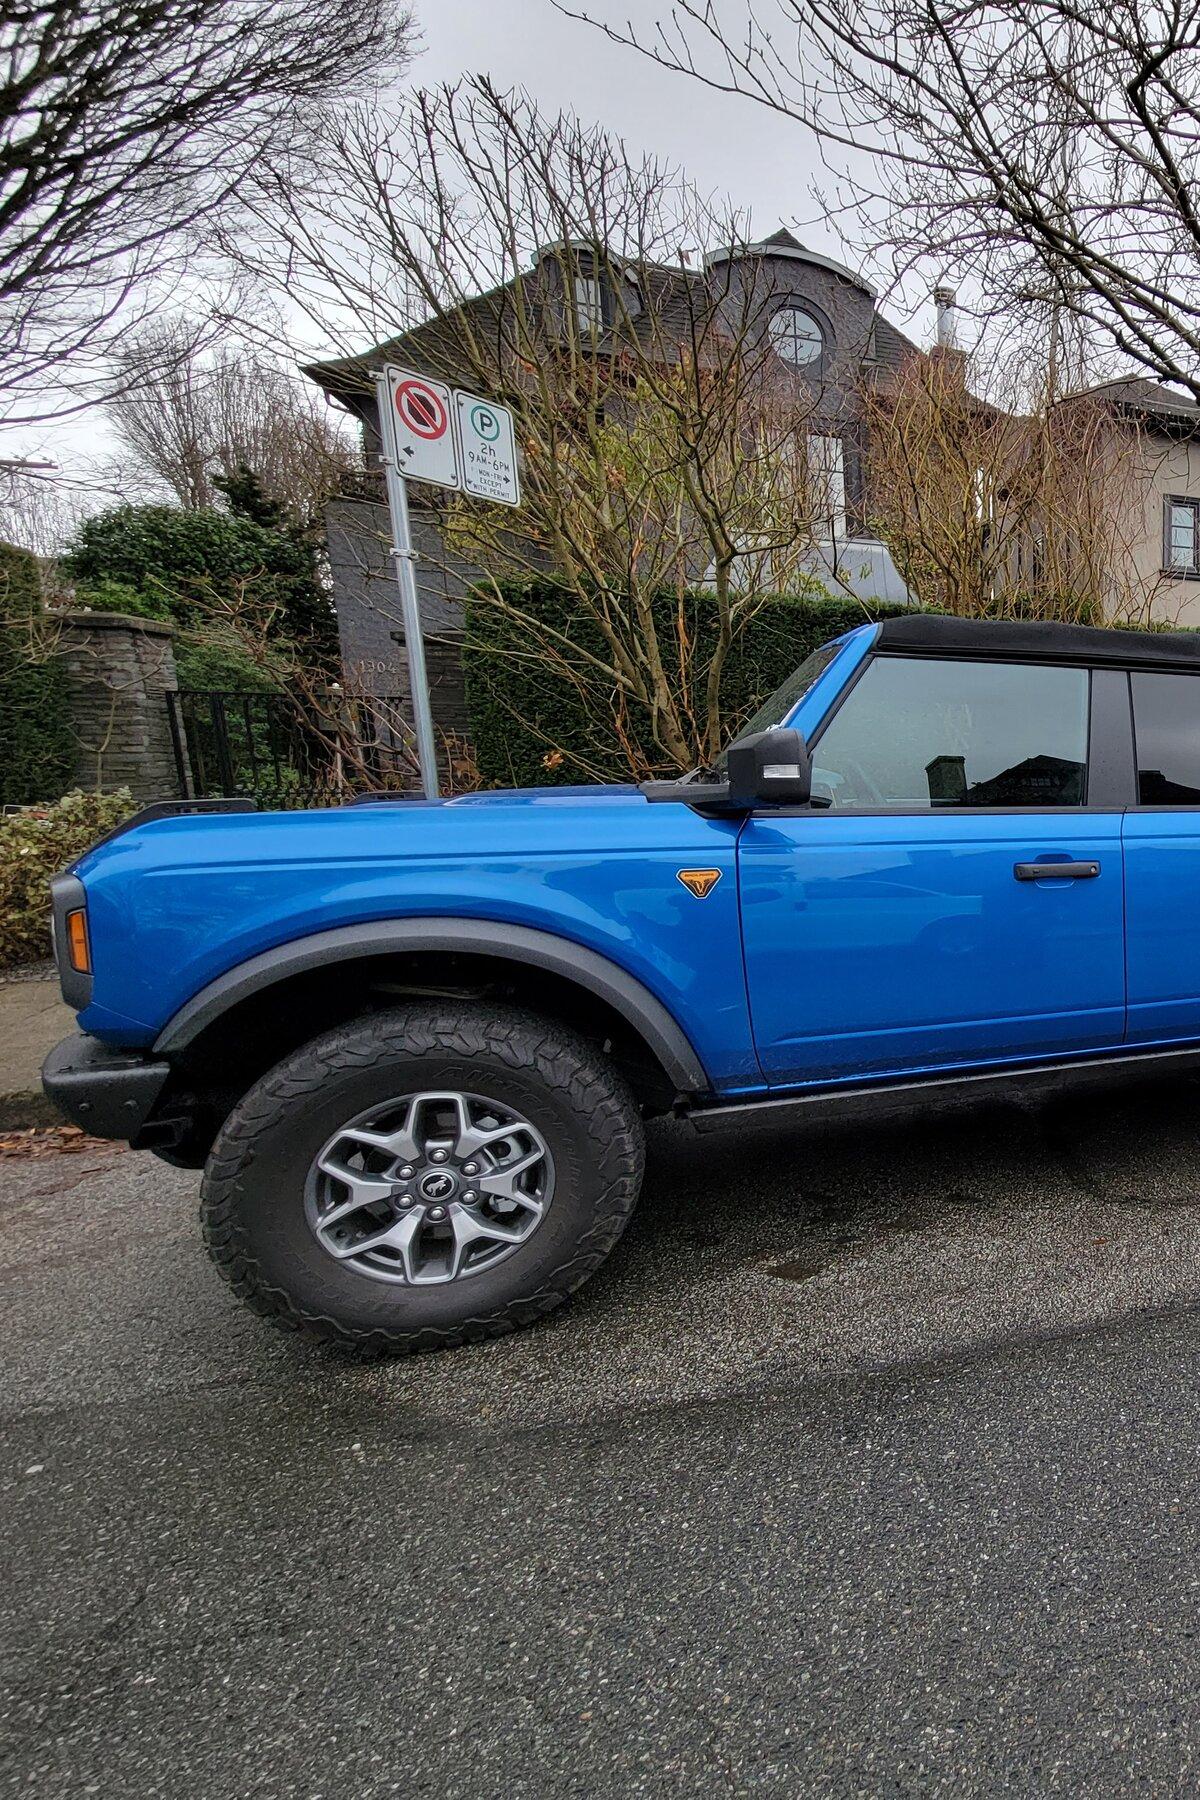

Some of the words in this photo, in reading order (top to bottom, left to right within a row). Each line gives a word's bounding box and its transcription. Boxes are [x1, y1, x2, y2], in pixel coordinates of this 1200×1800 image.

[479, 412, 493, 432] P
[481, 443, 496, 458] 2h
[479, 477, 502, 489] EXCEPT
[473, 483, 487, 493] WITH
[489, 488, 510, 499] PERMIT
